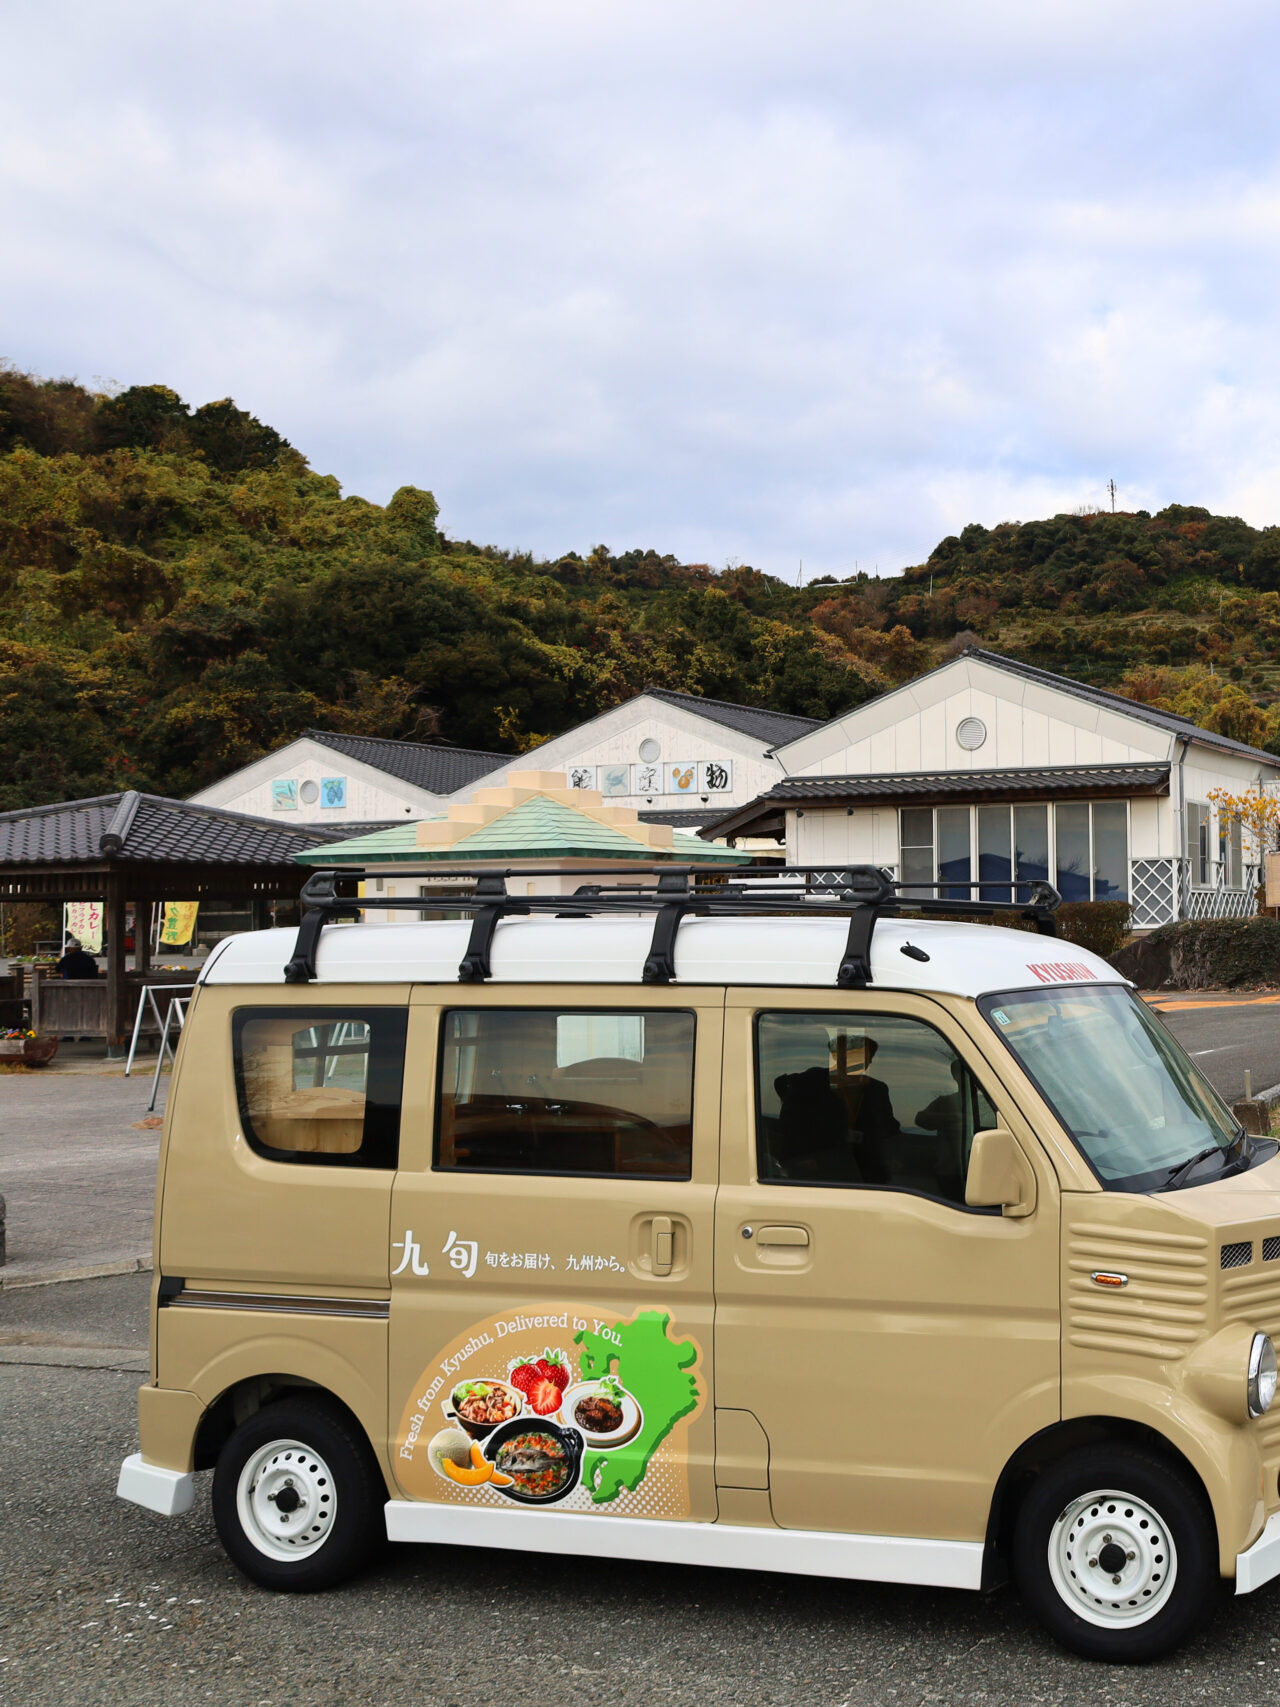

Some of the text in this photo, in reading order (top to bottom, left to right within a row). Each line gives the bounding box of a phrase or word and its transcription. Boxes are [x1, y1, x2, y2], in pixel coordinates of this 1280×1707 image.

[392, 1230, 479, 1278] 九旬
[400, 1312, 623, 1461] Fresh from Kyushu, Delivered to You.
